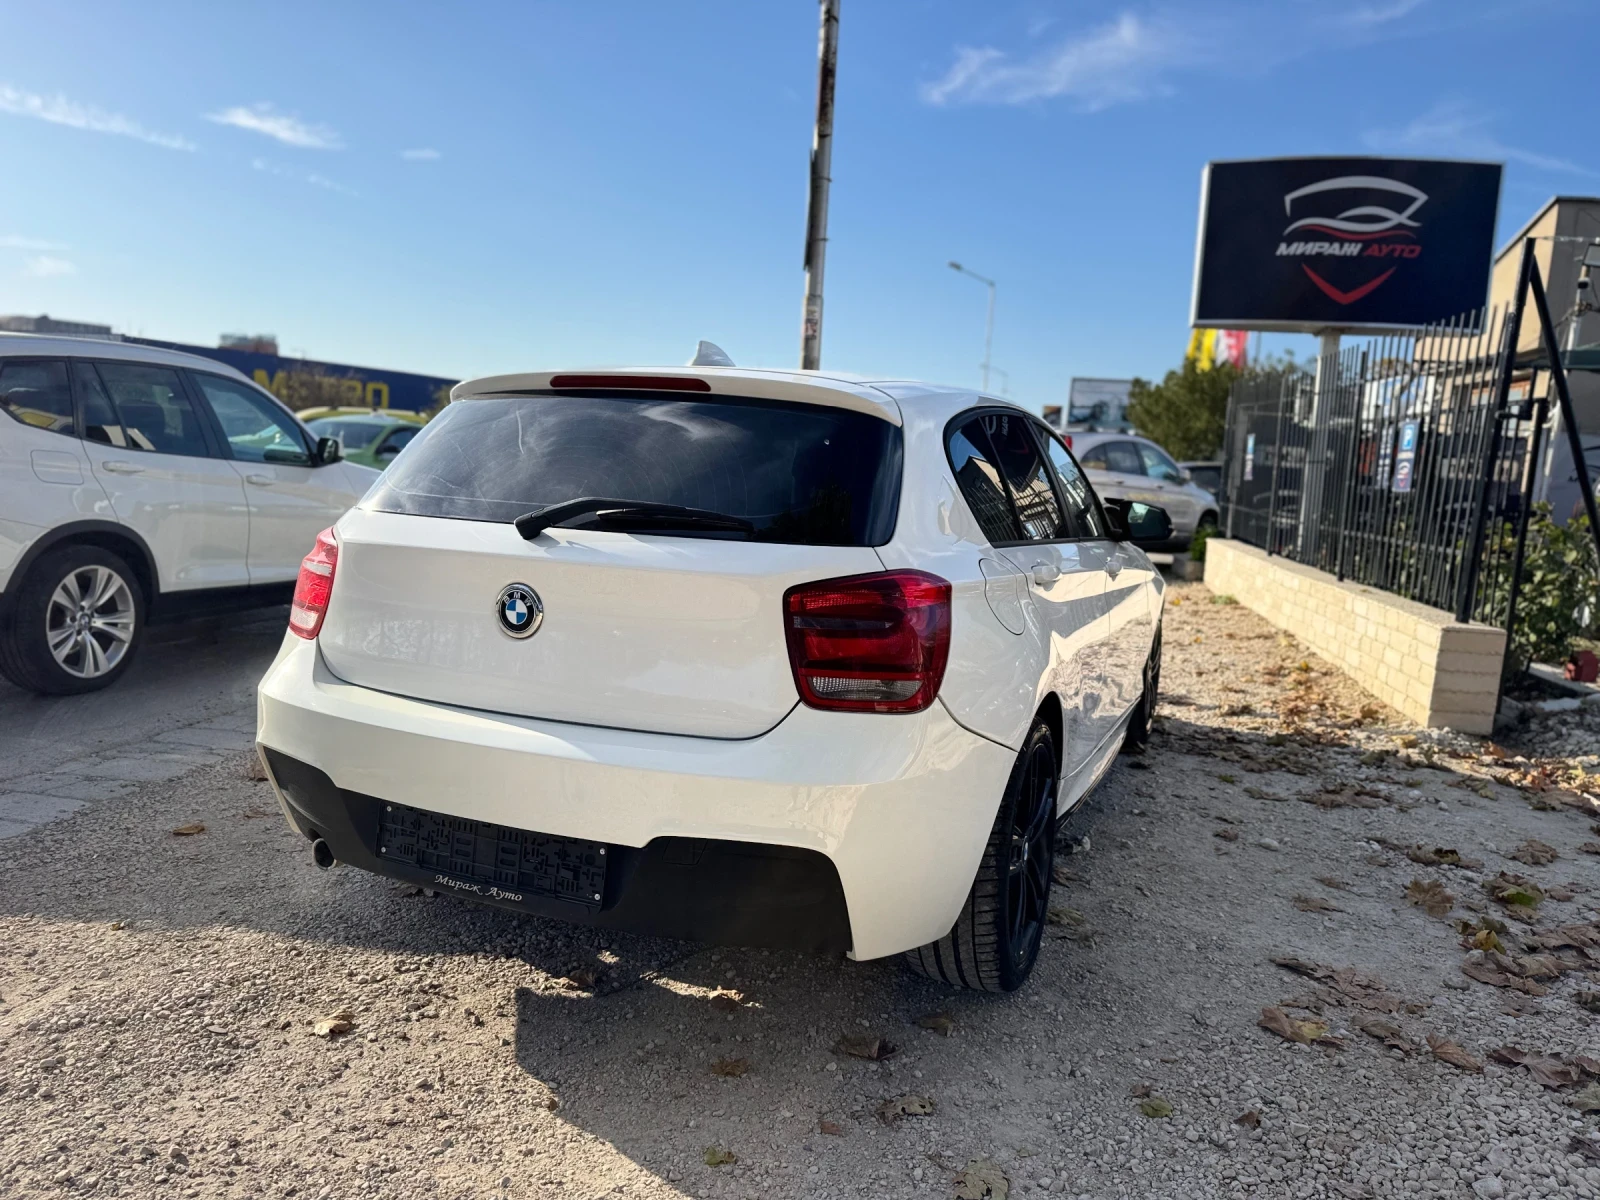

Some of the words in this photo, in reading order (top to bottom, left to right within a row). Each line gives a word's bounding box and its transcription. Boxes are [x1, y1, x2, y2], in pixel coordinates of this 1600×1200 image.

[1275, 241, 1363, 257] МИРАЖ
[1363, 243, 1422, 259] АУТО
[253, 368, 389, 409] MTRO
[503, 591, 532, 607] BMW
[434, 874, 483, 895] Мираж
[485, 886, 523, 902] Ауто
